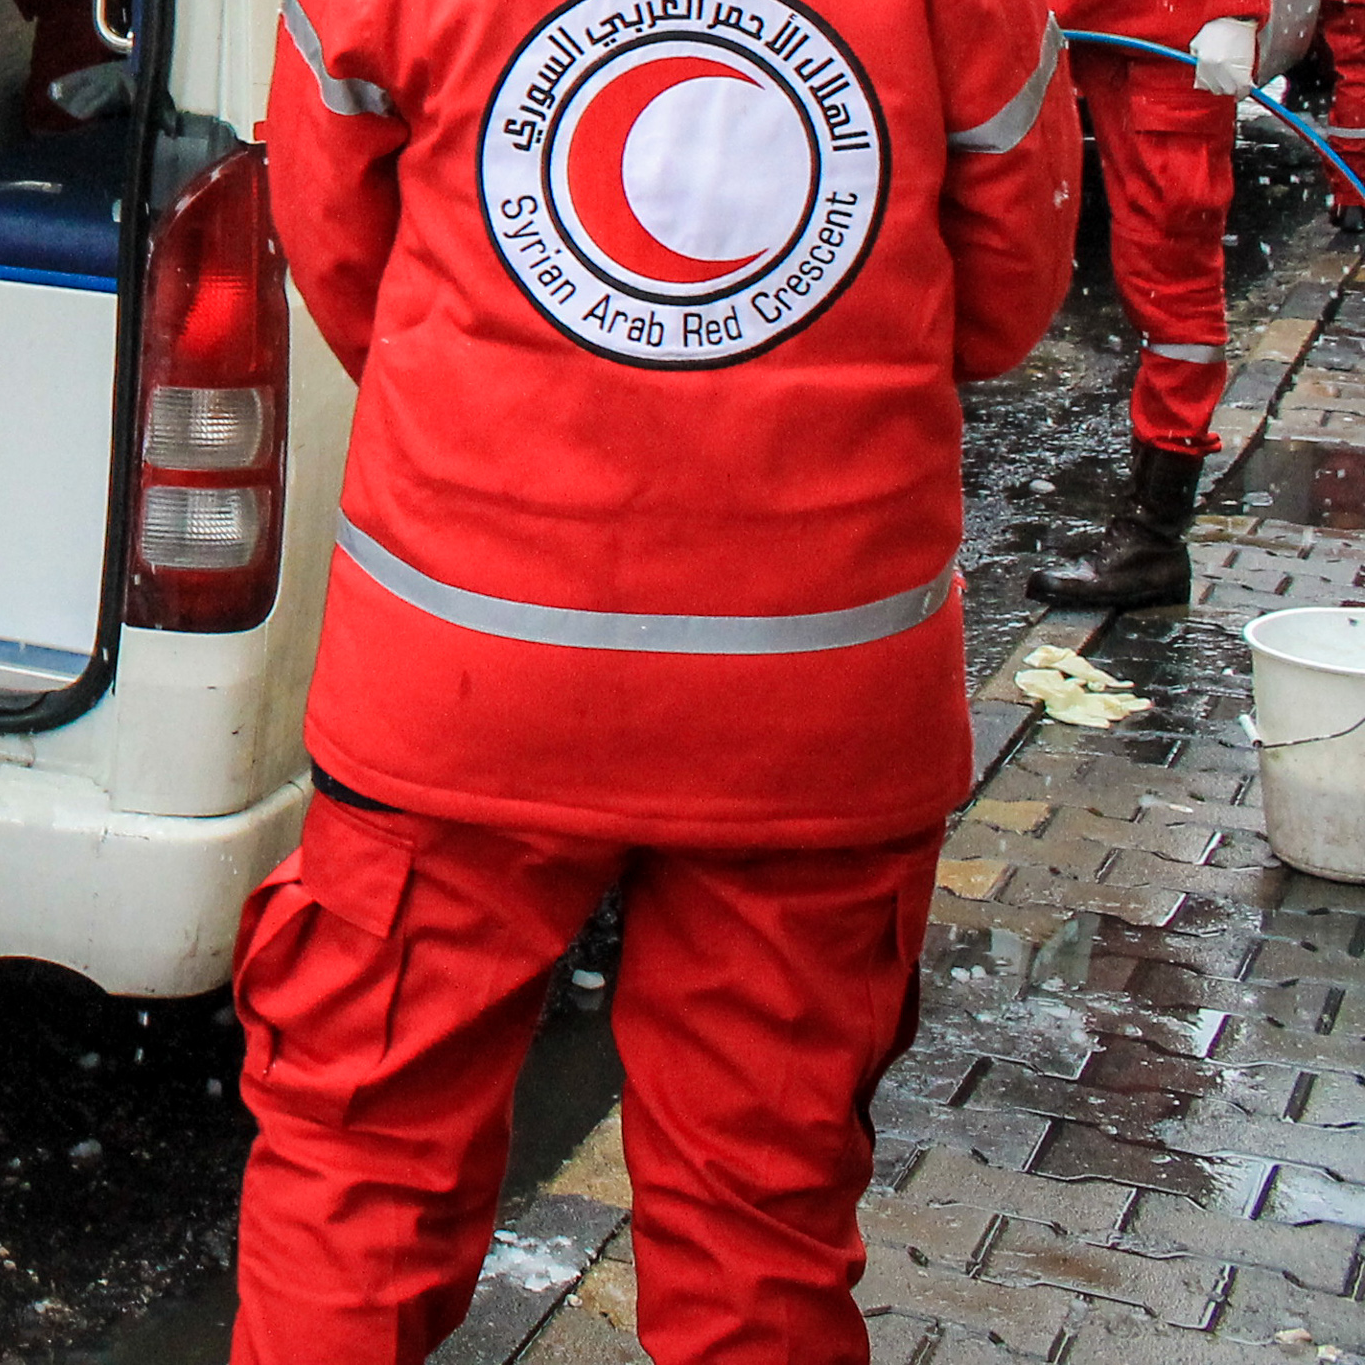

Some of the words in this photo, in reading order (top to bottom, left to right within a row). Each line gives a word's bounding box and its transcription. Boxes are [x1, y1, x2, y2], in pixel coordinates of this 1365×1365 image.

[706, 0, 808, 61] الأحمر
[503, 25, 585, 152] السوري
[793, 57, 871, 152] الهلال
[500, 194, 577, 306] Syrian
[582, 293, 665, 348] Arab
[682, 306, 743, 348] Red
[751, 190, 859, 324] Crescent
